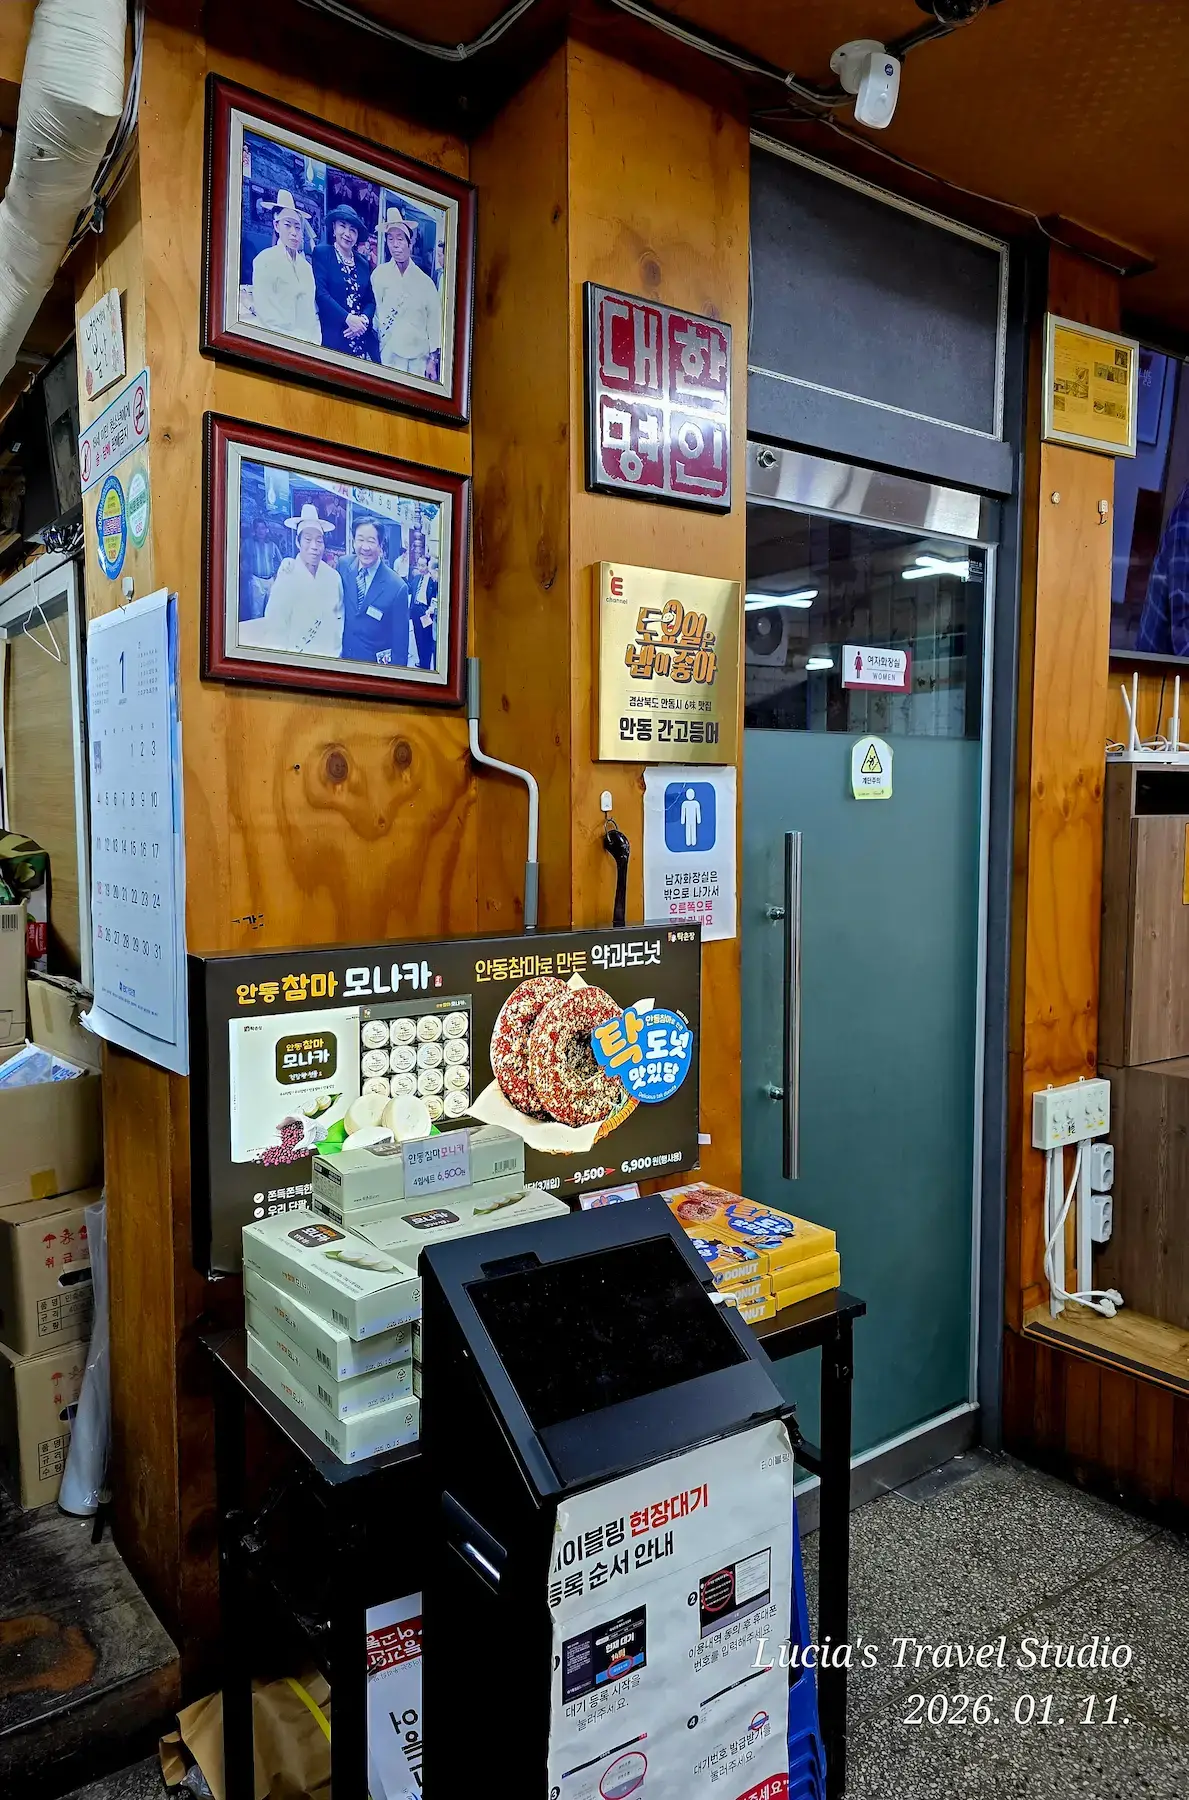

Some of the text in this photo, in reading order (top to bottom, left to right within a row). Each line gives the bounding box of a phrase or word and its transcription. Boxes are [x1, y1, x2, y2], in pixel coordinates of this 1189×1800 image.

[603, 299, 727, 402] 대한
[602, 405, 724, 492] 명인
[606, 597, 628, 605] channel
[119, 651, 125, 694] 1
[867, 655, 901, 669] 여자화장실
[872, 672, 896, 681] WOMEN
[629, 696, 659, 709] 경상북도
[661, 698, 683, 710] 안동시
[698, 700, 712, 712] 맛집
[619, 717, 720, 744] 안동 간고등어
[151, 740, 156, 756] 3
[862, 776, 881, 785] 계단주의
[151, 792, 158, 807] 10
[130, 840, 137, 856] 15
[141, 842, 147, 858] 16
[152, 843, 159, 859] 17
[665, 870, 718, 886] 남자화장실은
[113, 884, 119, 899] 20
[131, 888, 138, 904] 22
[141, 891, 149, 907] 23
[153, 894, 161, 909] 24
[664, 885, 720, 901] 밖으로 나가서
[669, 900, 713, 915] 오른쪽으로
[105, 927, 111, 942] 26
[114, 930, 121, 945] 27
[122, 933, 130, 949] 28
[132, 936, 140, 952] 29
[142, 940, 150, 956] 30
[154, 945, 162, 960] 31
[475, 940, 661, 983] 안동참마로 만든 약과도넛
[235, 960, 432, 1005] 안동참마 모나카
[285, 1038, 325, 1052] 안동참마
[594, 1011, 644, 1069] 탁
[645, 1029, 690, 1059] 도넛
[281, 1048, 331, 1069] 모나카
[628, 1061, 680, 1090] 맛있당
[413, 1167, 466, 1186] 4입세트 6,500원
[573, 1166, 605, 1185] 9,500
[621, 1157, 651, 1174] 6,900
[267, 1203, 286, 1216] 우리
[723, 1262, 759, 1282] DONUT
[629, 1483, 708, 1538] 현장대기
[549, 1530, 674, 1608] 등록 순서 안내
[688, 1604, 778, 1658] 이용내역 동의 후 휴대폰
[694, 1623, 773, 1673] 번호를 입력해주세요.
[565, 1674, 641, 1719] 대기 등록 시작을
[576, 1697, 629, 1732] 눌러주세요.
[693, 1722, 772, 1775] 대기번호 발급받기를
[710, 1751, 756, 1783] 눌러주세요.
